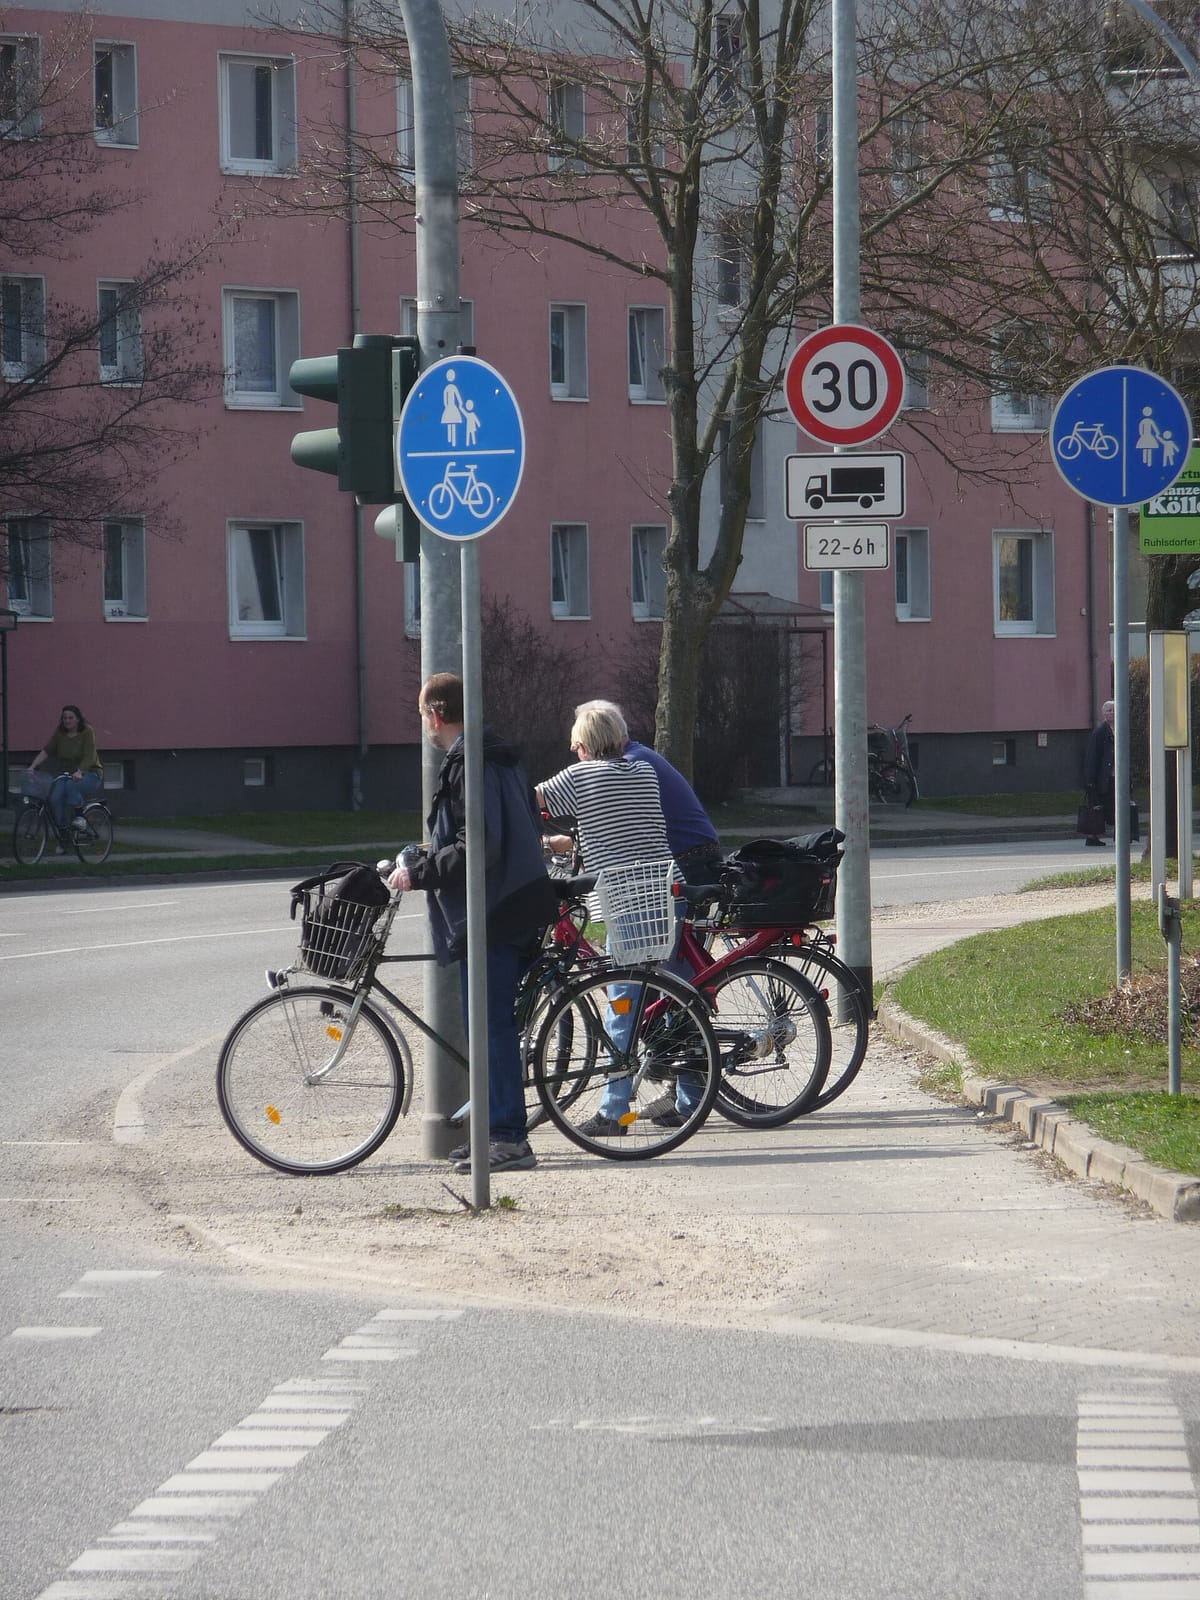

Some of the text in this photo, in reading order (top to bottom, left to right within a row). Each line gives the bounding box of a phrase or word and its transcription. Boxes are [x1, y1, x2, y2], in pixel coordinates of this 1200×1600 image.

[811, 359, 878, 413] 30
[1164, 486, 1200, 496] anze
[1143, 538, 1197, 547] Ruhlsdorfer
